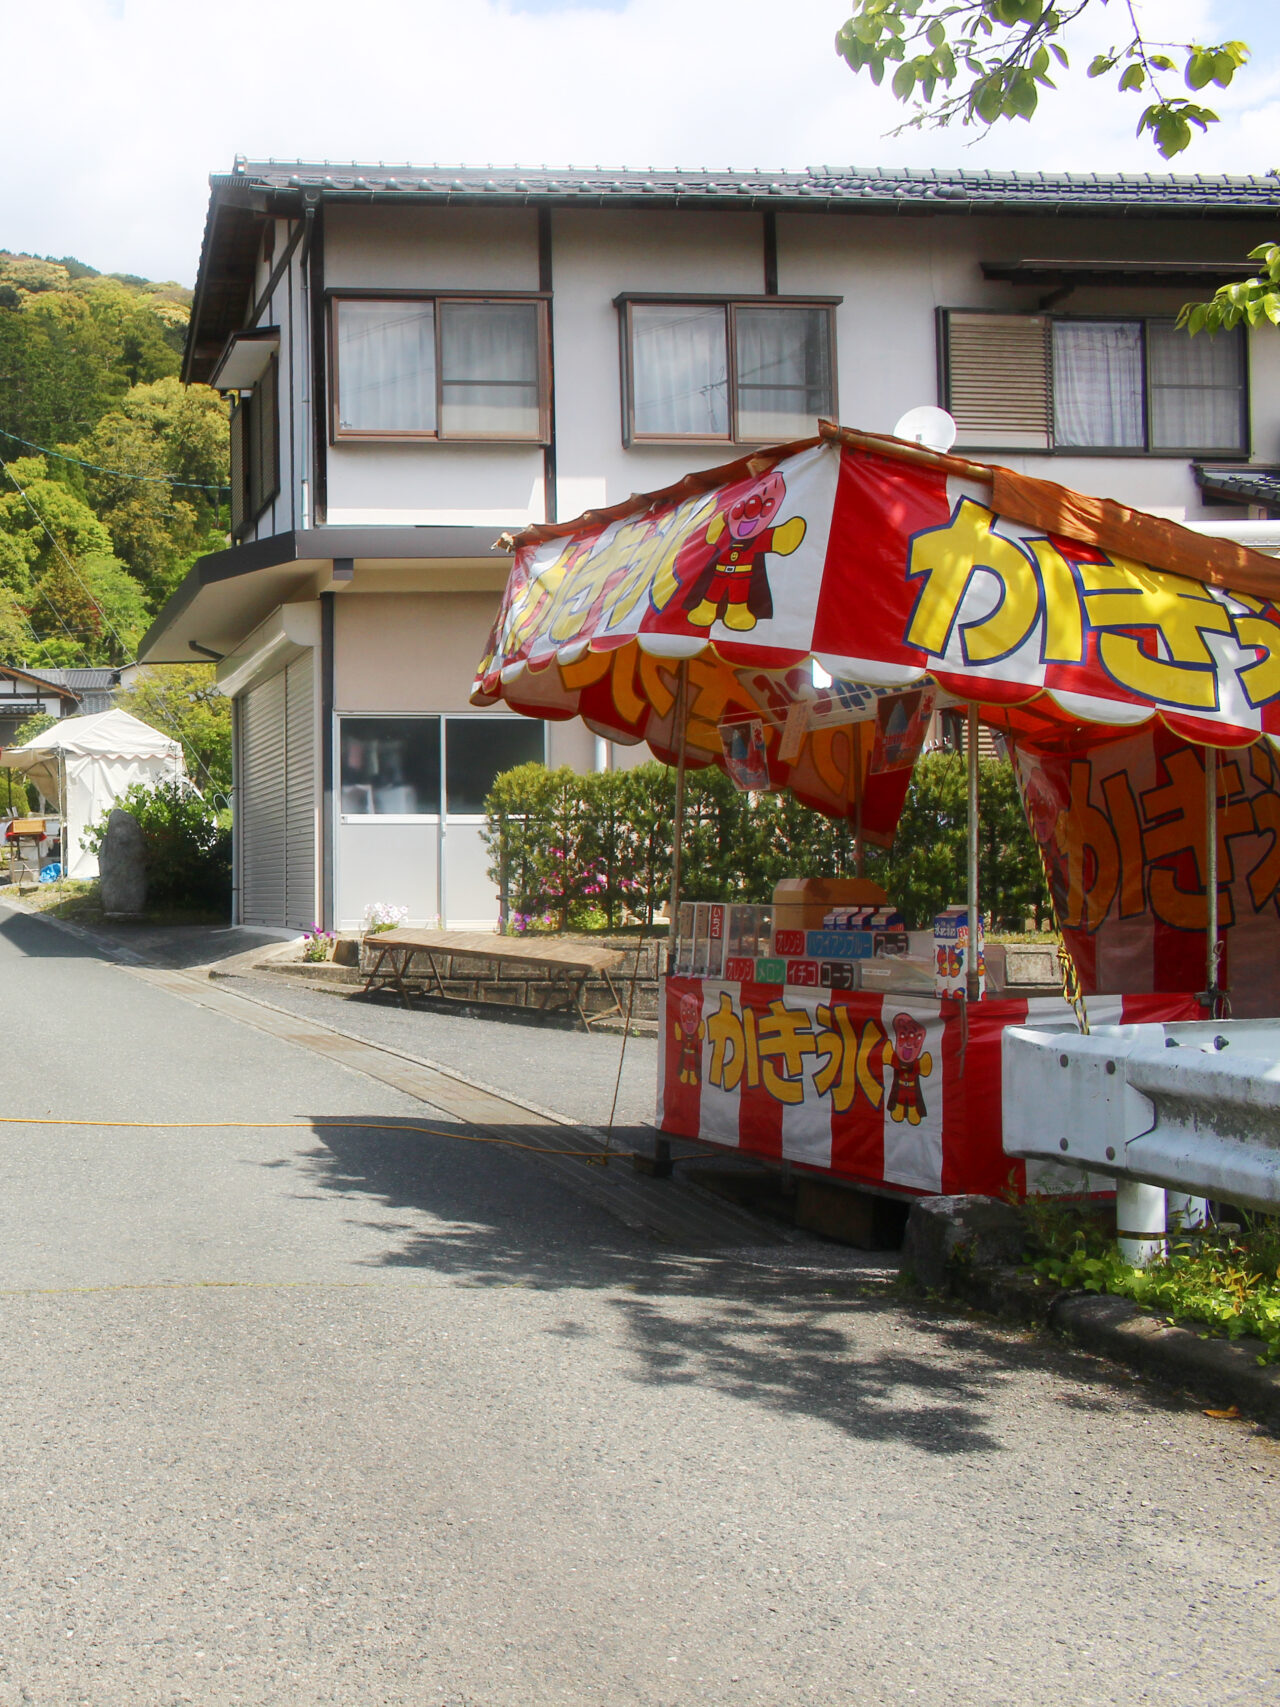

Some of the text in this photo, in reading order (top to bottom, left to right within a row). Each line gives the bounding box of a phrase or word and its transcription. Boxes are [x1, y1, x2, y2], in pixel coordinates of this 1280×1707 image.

[822, 964, 853, 987] コーラ
[707, 990, 886, 1114] かき氷
